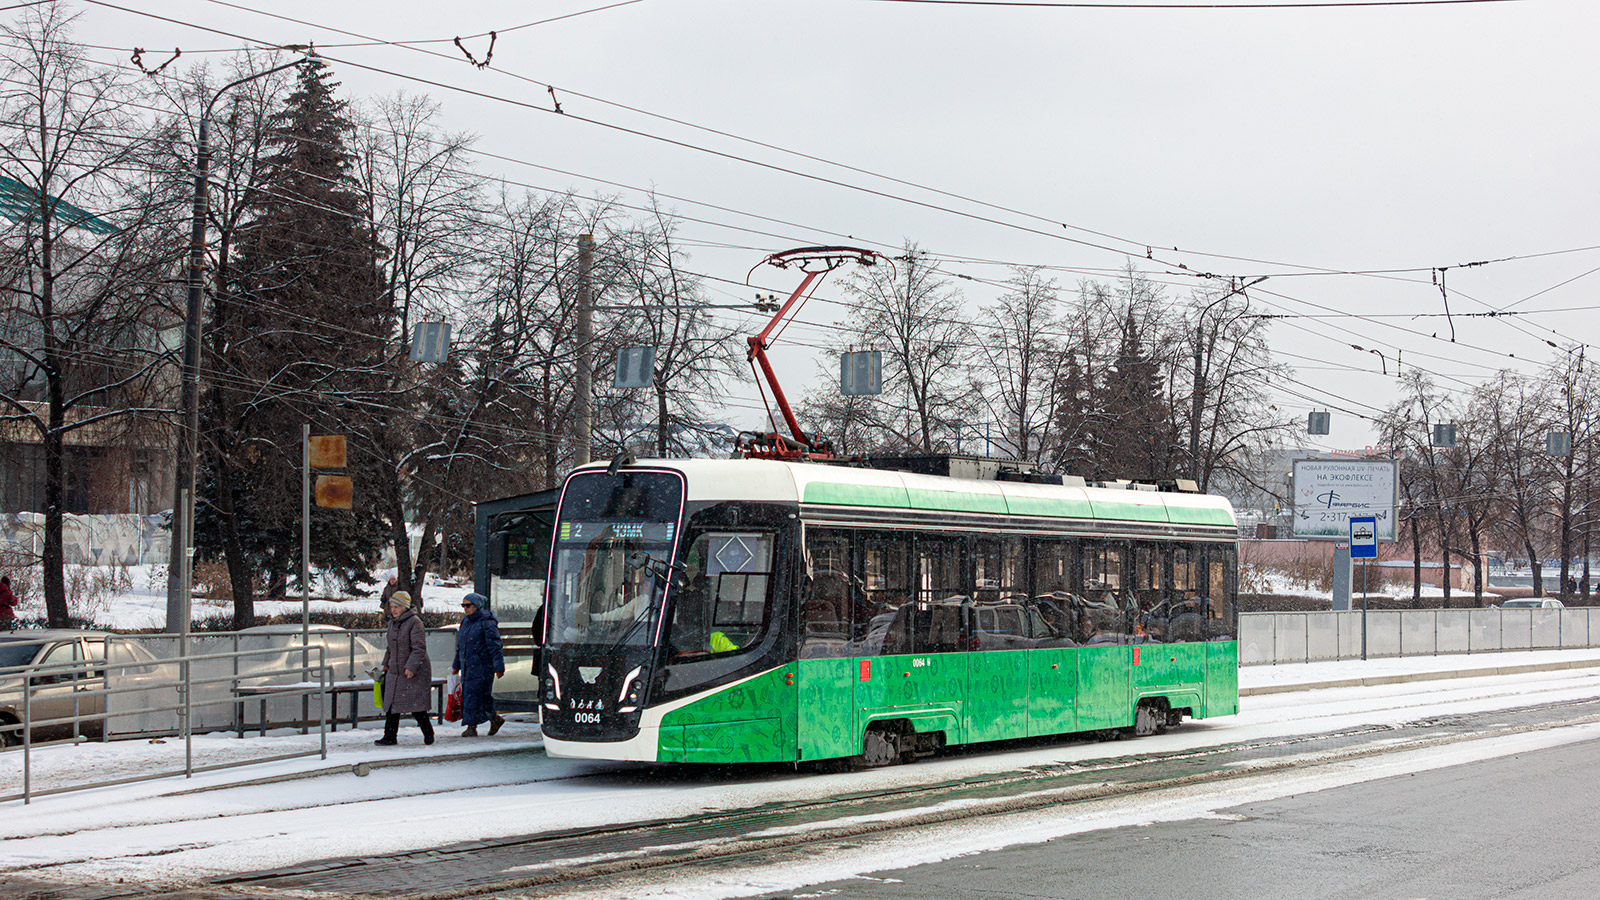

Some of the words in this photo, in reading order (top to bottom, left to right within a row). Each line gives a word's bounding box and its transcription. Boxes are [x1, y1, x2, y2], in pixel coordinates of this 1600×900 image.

[574, 522, 583, 538] 2
[612, 522, 644, 538] ЧЭМК
[912, 658, 925, 667] 0064
[575, 712, 601, 724] 0064
